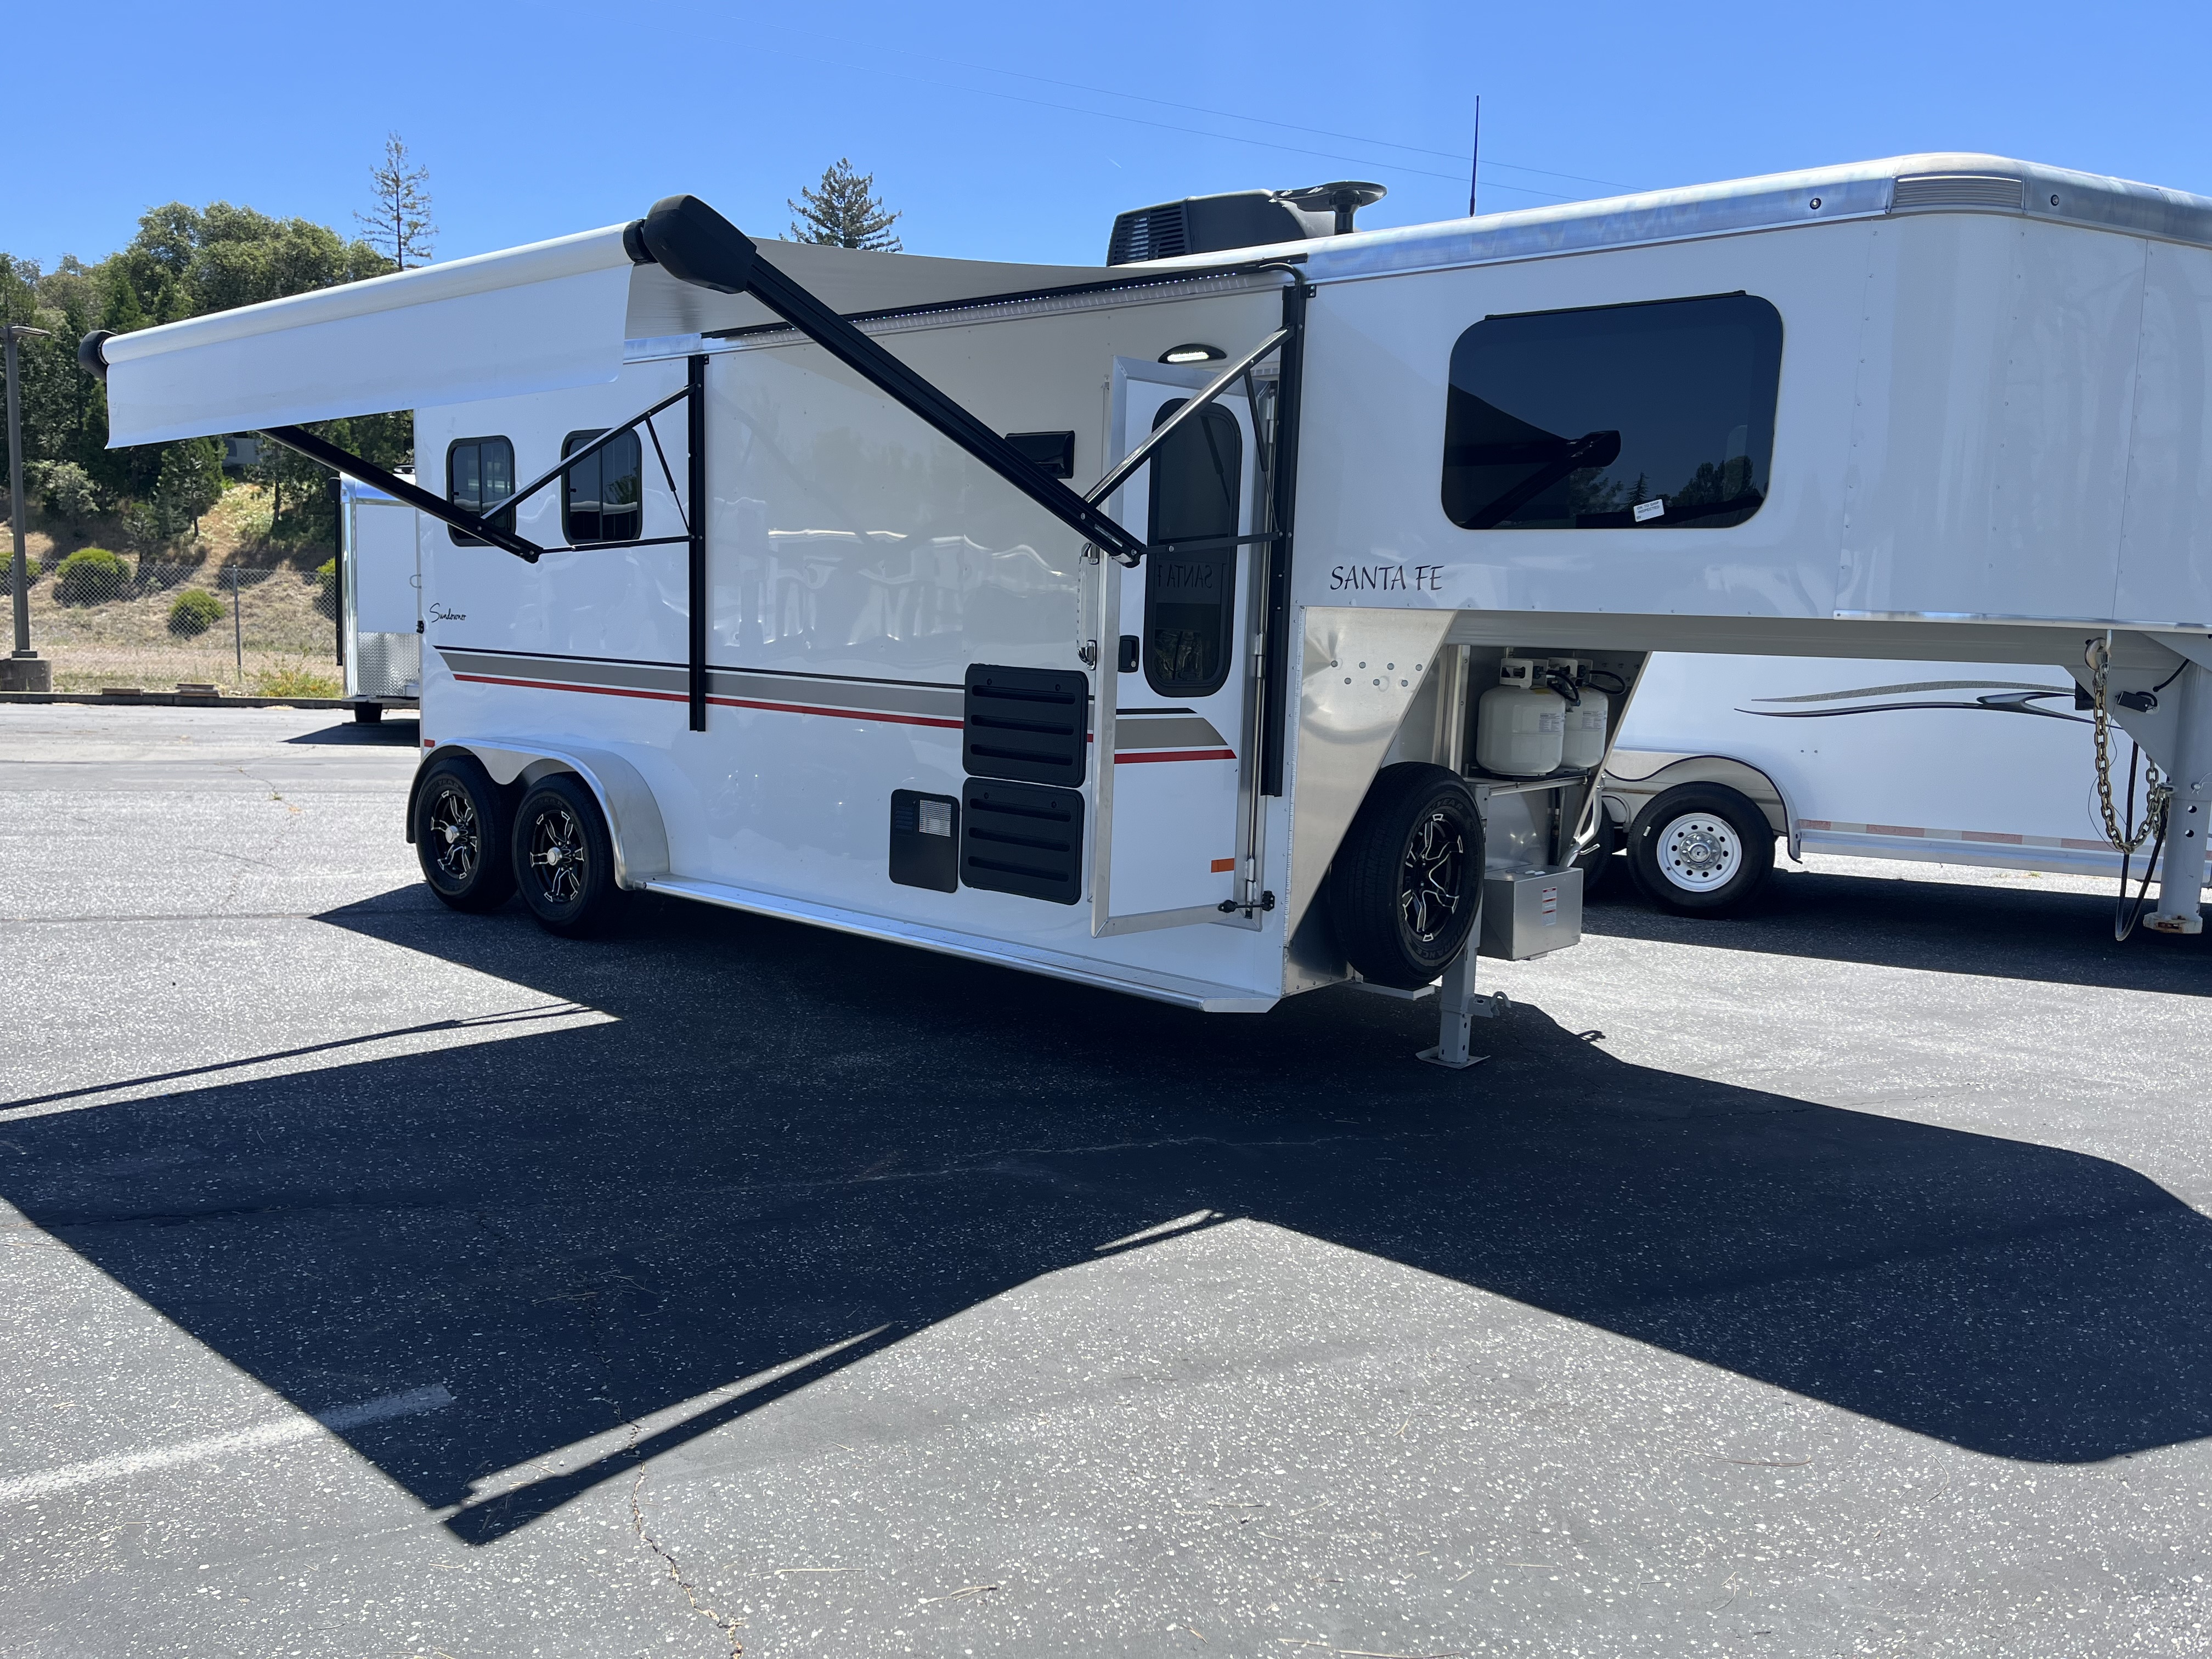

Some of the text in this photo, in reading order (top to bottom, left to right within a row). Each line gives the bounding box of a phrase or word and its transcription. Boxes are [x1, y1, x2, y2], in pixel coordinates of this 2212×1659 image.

[1330, 565, 1445, 591] SANTA FE
[429, 602, 466, 623] Sundowner
